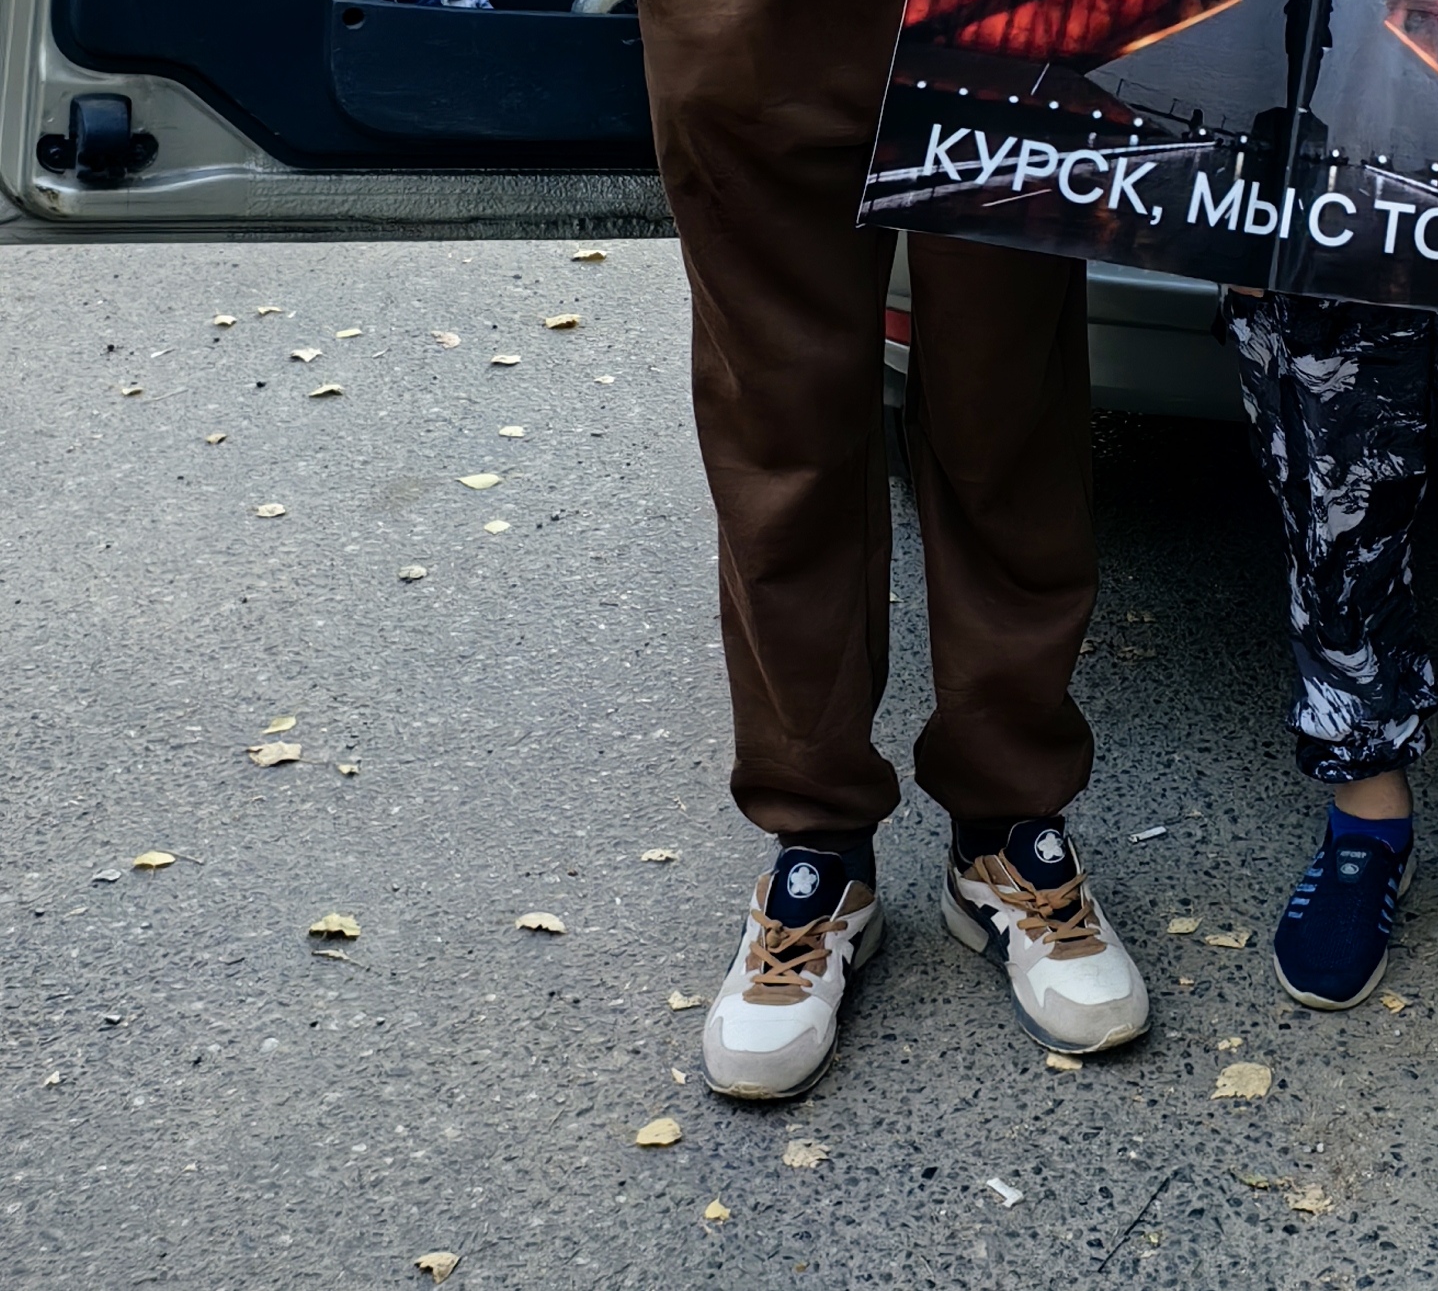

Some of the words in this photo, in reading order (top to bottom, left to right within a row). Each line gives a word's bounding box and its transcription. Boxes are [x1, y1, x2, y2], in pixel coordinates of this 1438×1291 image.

[923, 123, 1163, 225] КУРСК,
[1186, 170, 1296, 239] МЫ
[1308, 192, 1358, 247] С
